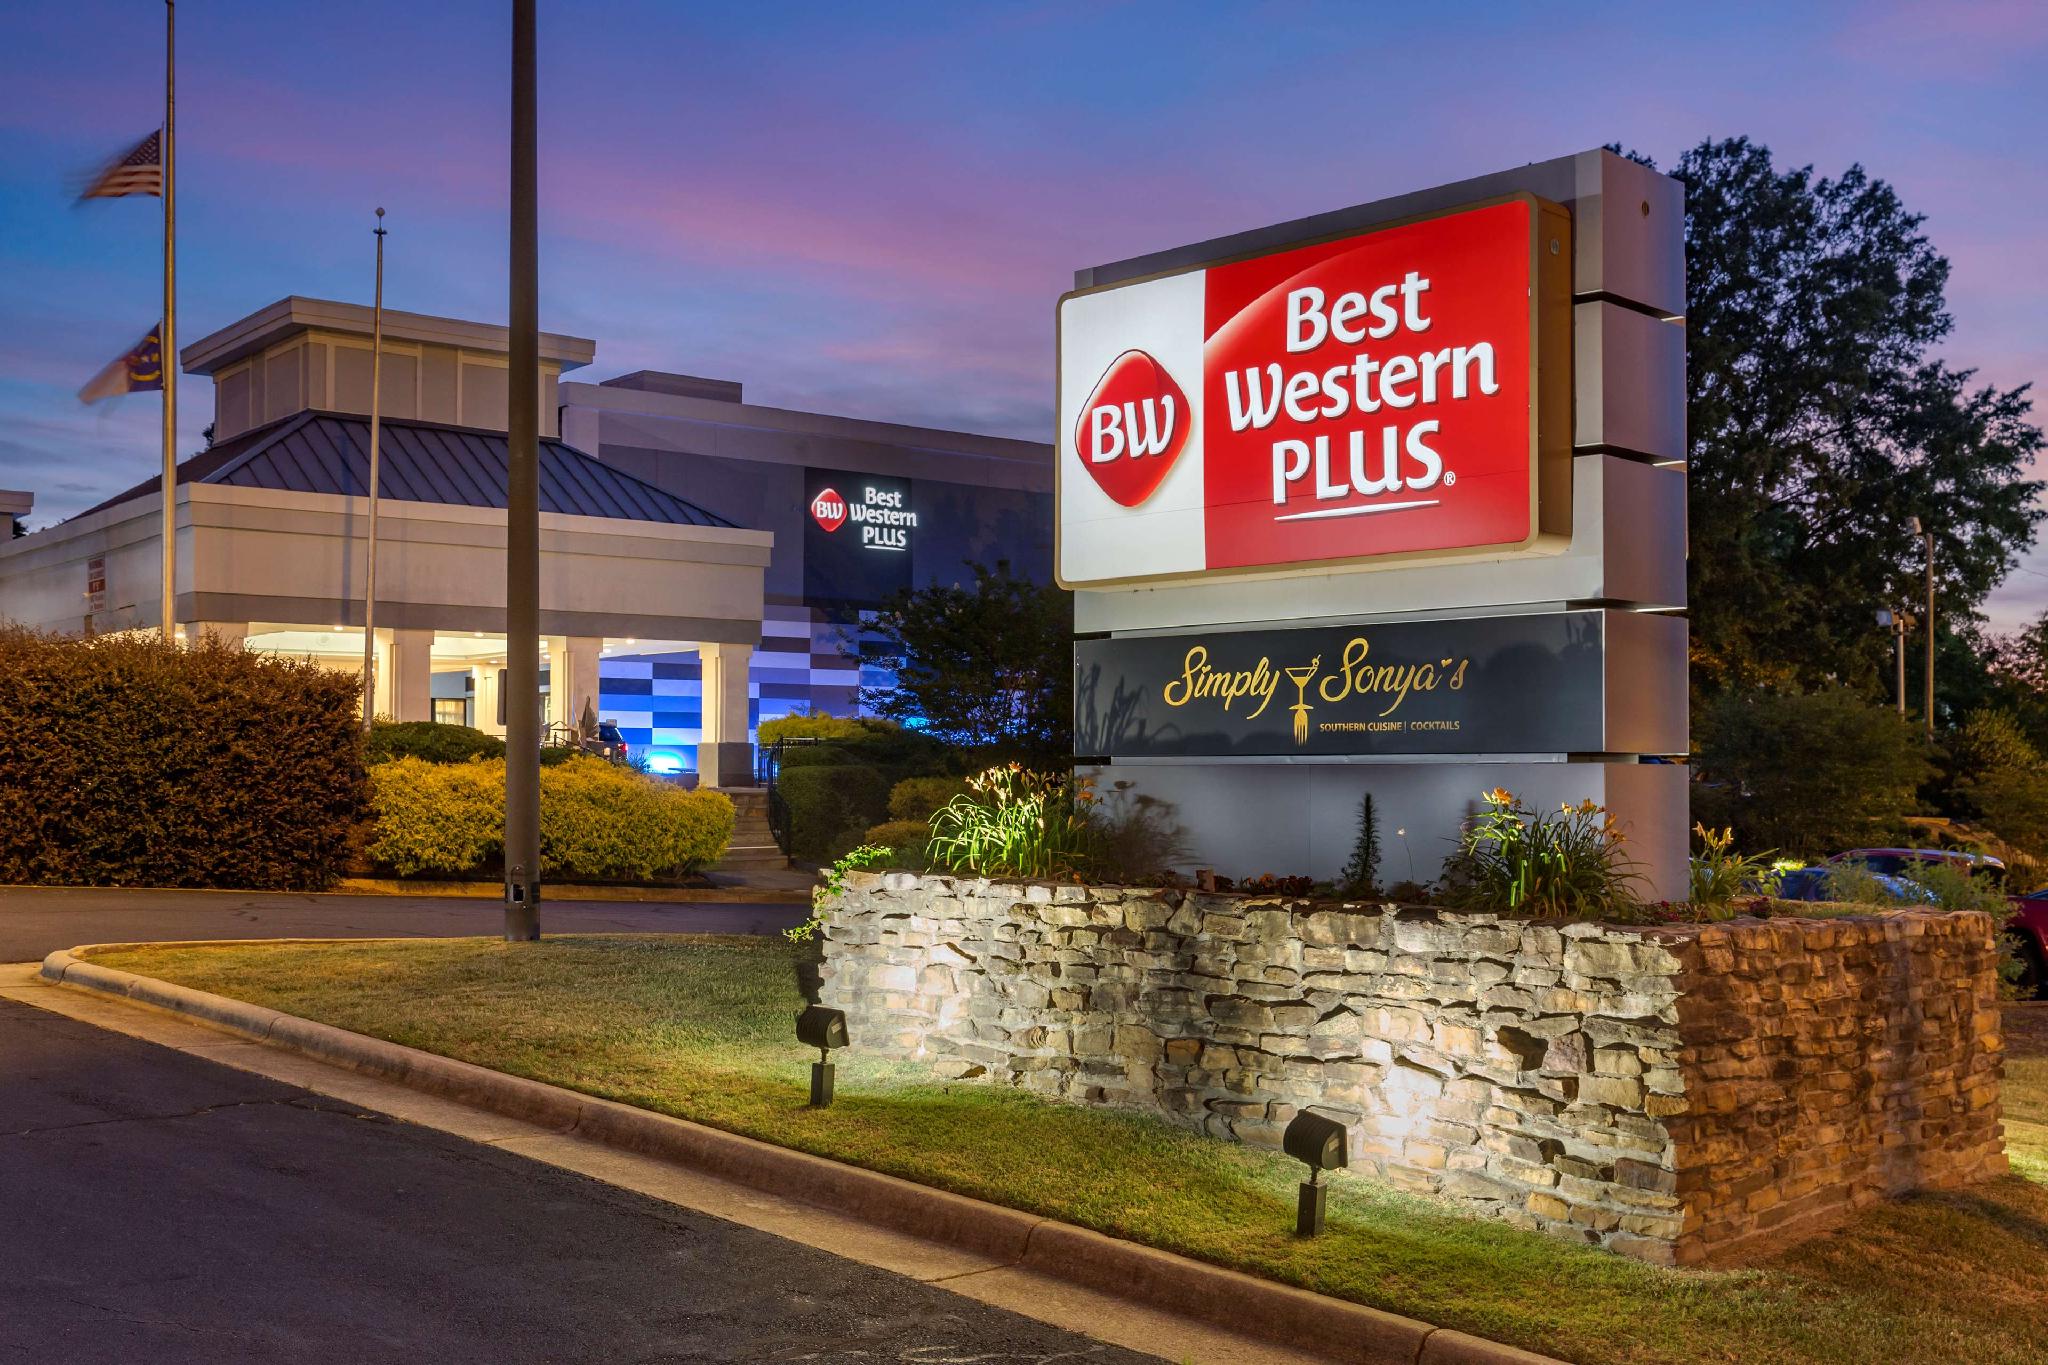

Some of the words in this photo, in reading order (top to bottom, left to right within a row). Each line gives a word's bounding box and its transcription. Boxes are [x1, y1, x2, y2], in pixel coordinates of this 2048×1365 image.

[1286, 271, 1431, 353] Best
[1224, 342, 1499, 432] Western
[1090, 394, 1175, 463] BW
[865, 487, 902, 508] Best
[816, 501, 843, 520] BW
[849, 503, 918, 527] Western
[863, 526, 907, 547] PLUS
[1163, 645, 1280, 720] Simply
[1319, 722, 1366, 733] SOUTHERN
[1367, 721, 1403, 732] CUISINE
[1410, 720, 1461, 731] COCKTAILS
